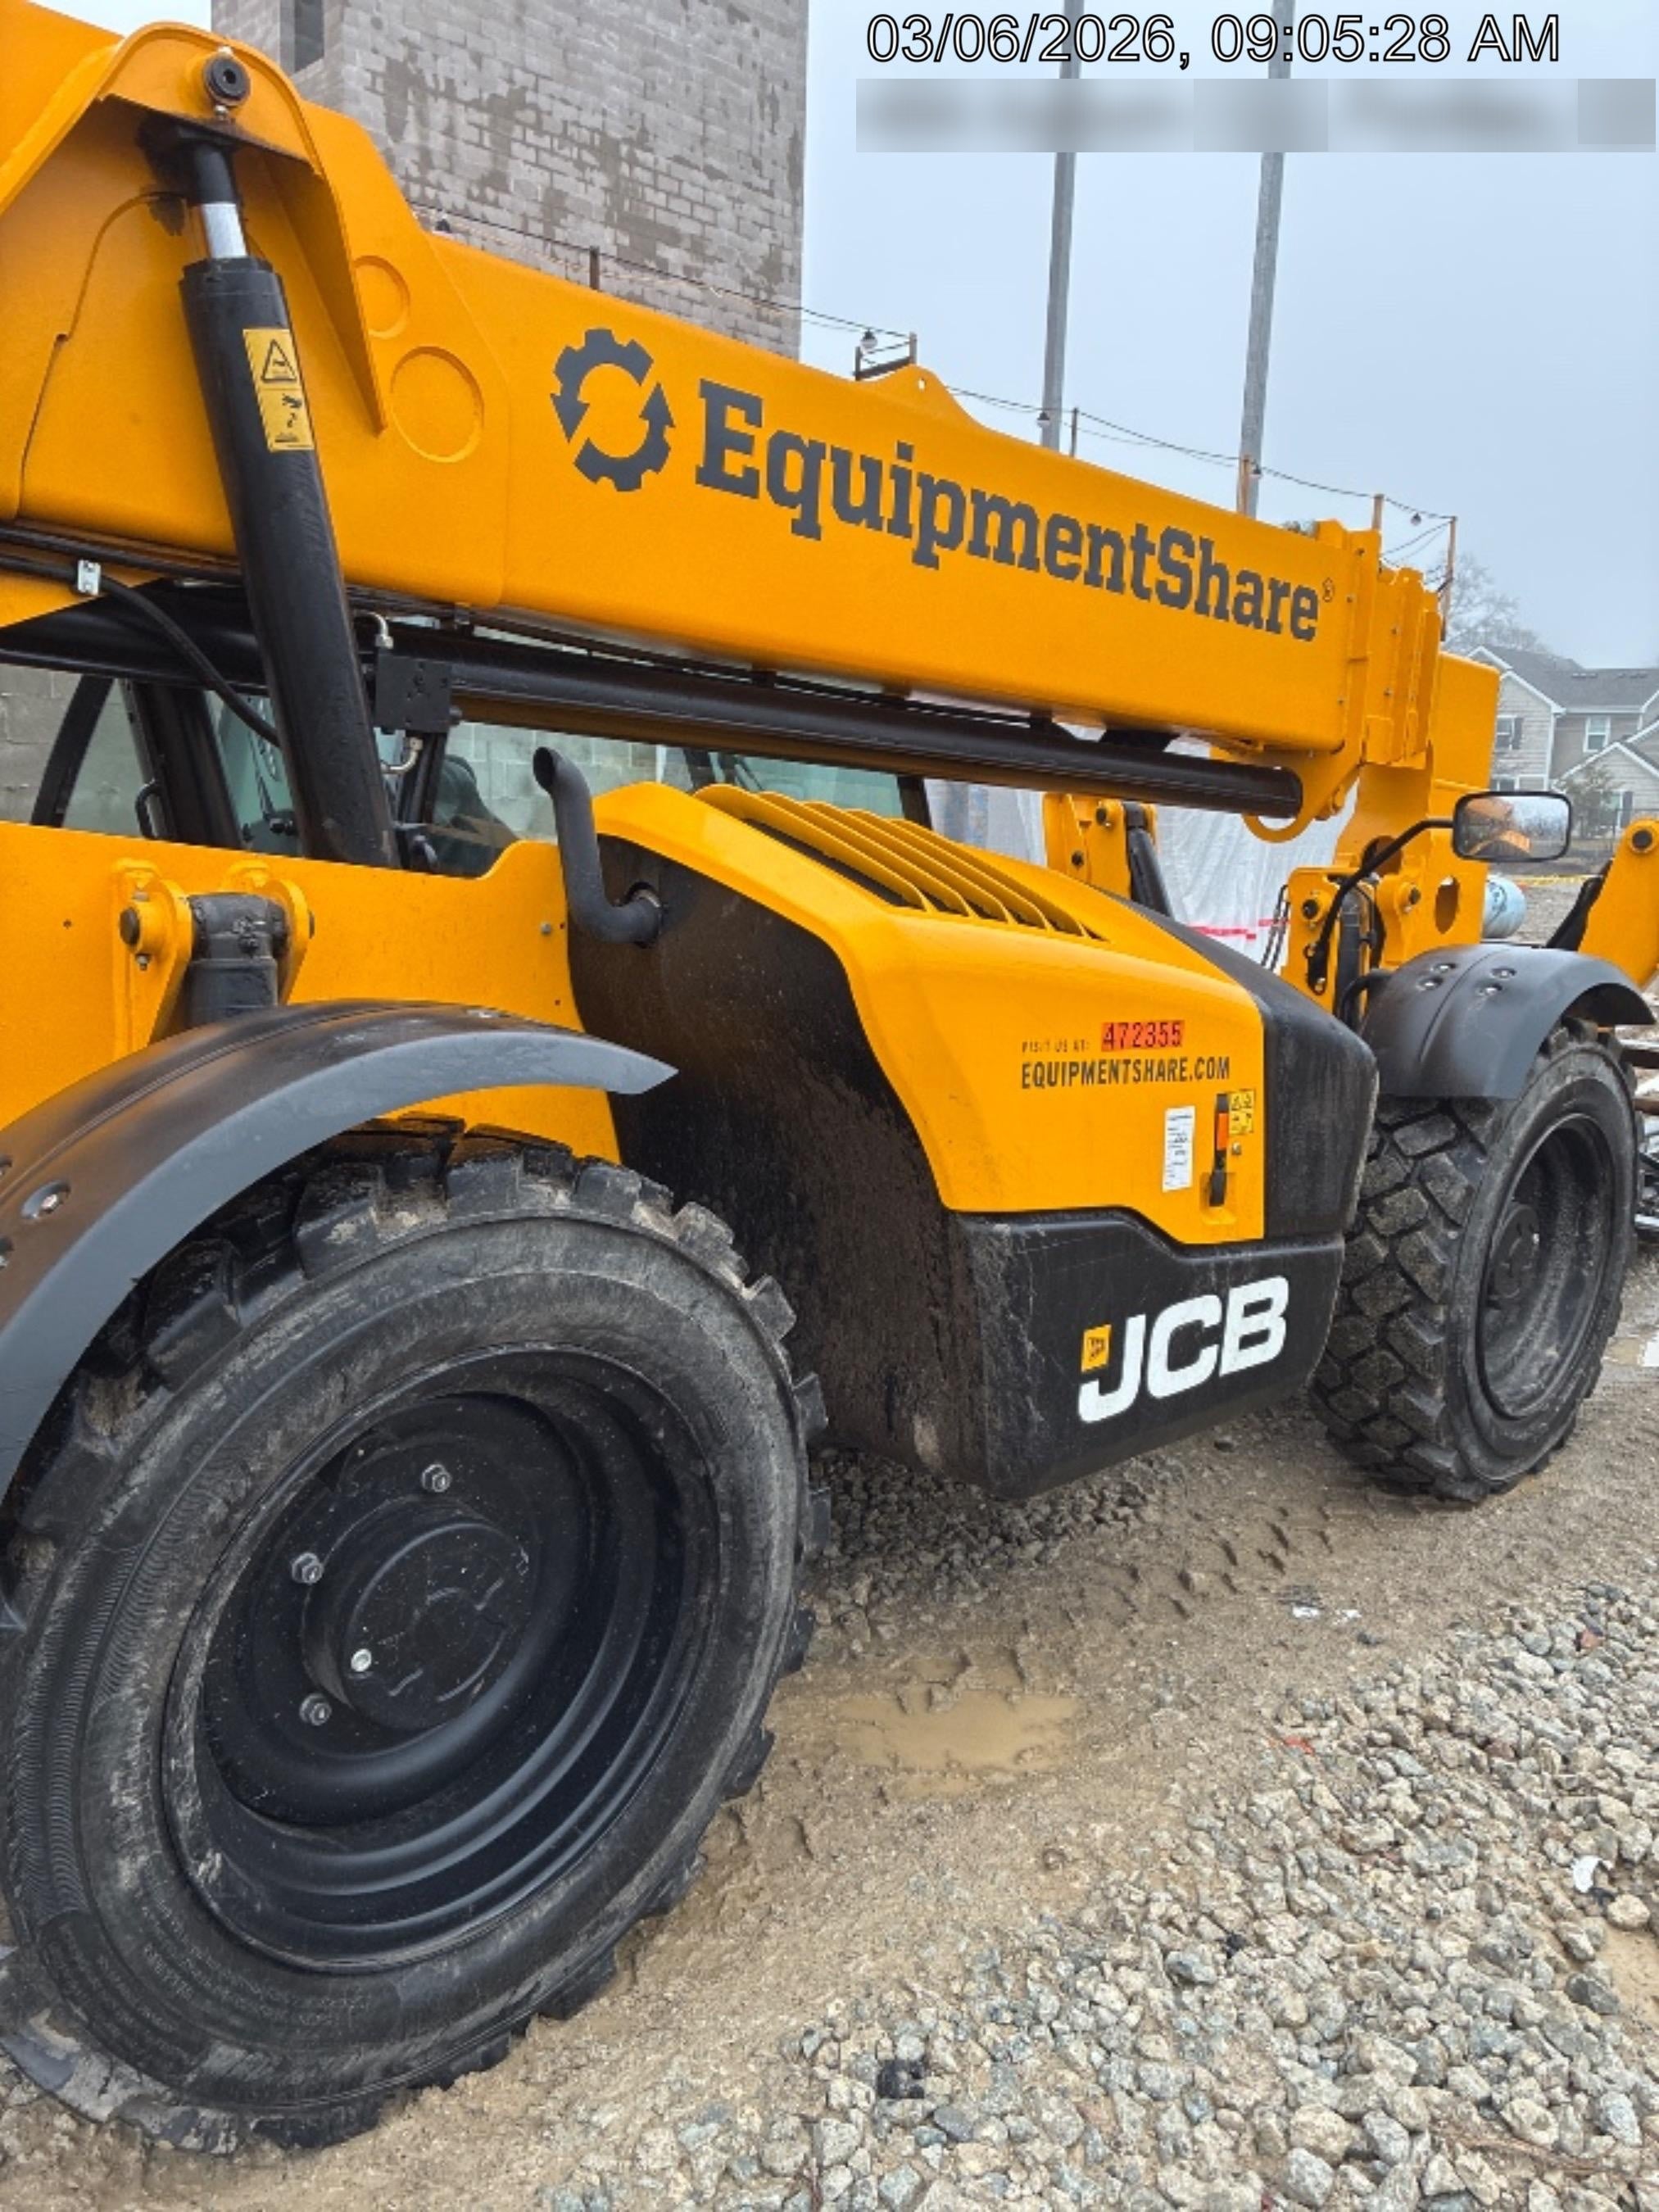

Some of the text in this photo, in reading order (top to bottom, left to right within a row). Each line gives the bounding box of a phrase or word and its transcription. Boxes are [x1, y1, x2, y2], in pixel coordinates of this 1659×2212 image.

[696, 378, 1318, 641] EquipmentShare
[1022, 1056, 1230, 1089] EQUIPMENTSHARE.COM
[1103, 1022, 1181, 1049] 472355
[1078, 1276, 1290, 1424] JCB
